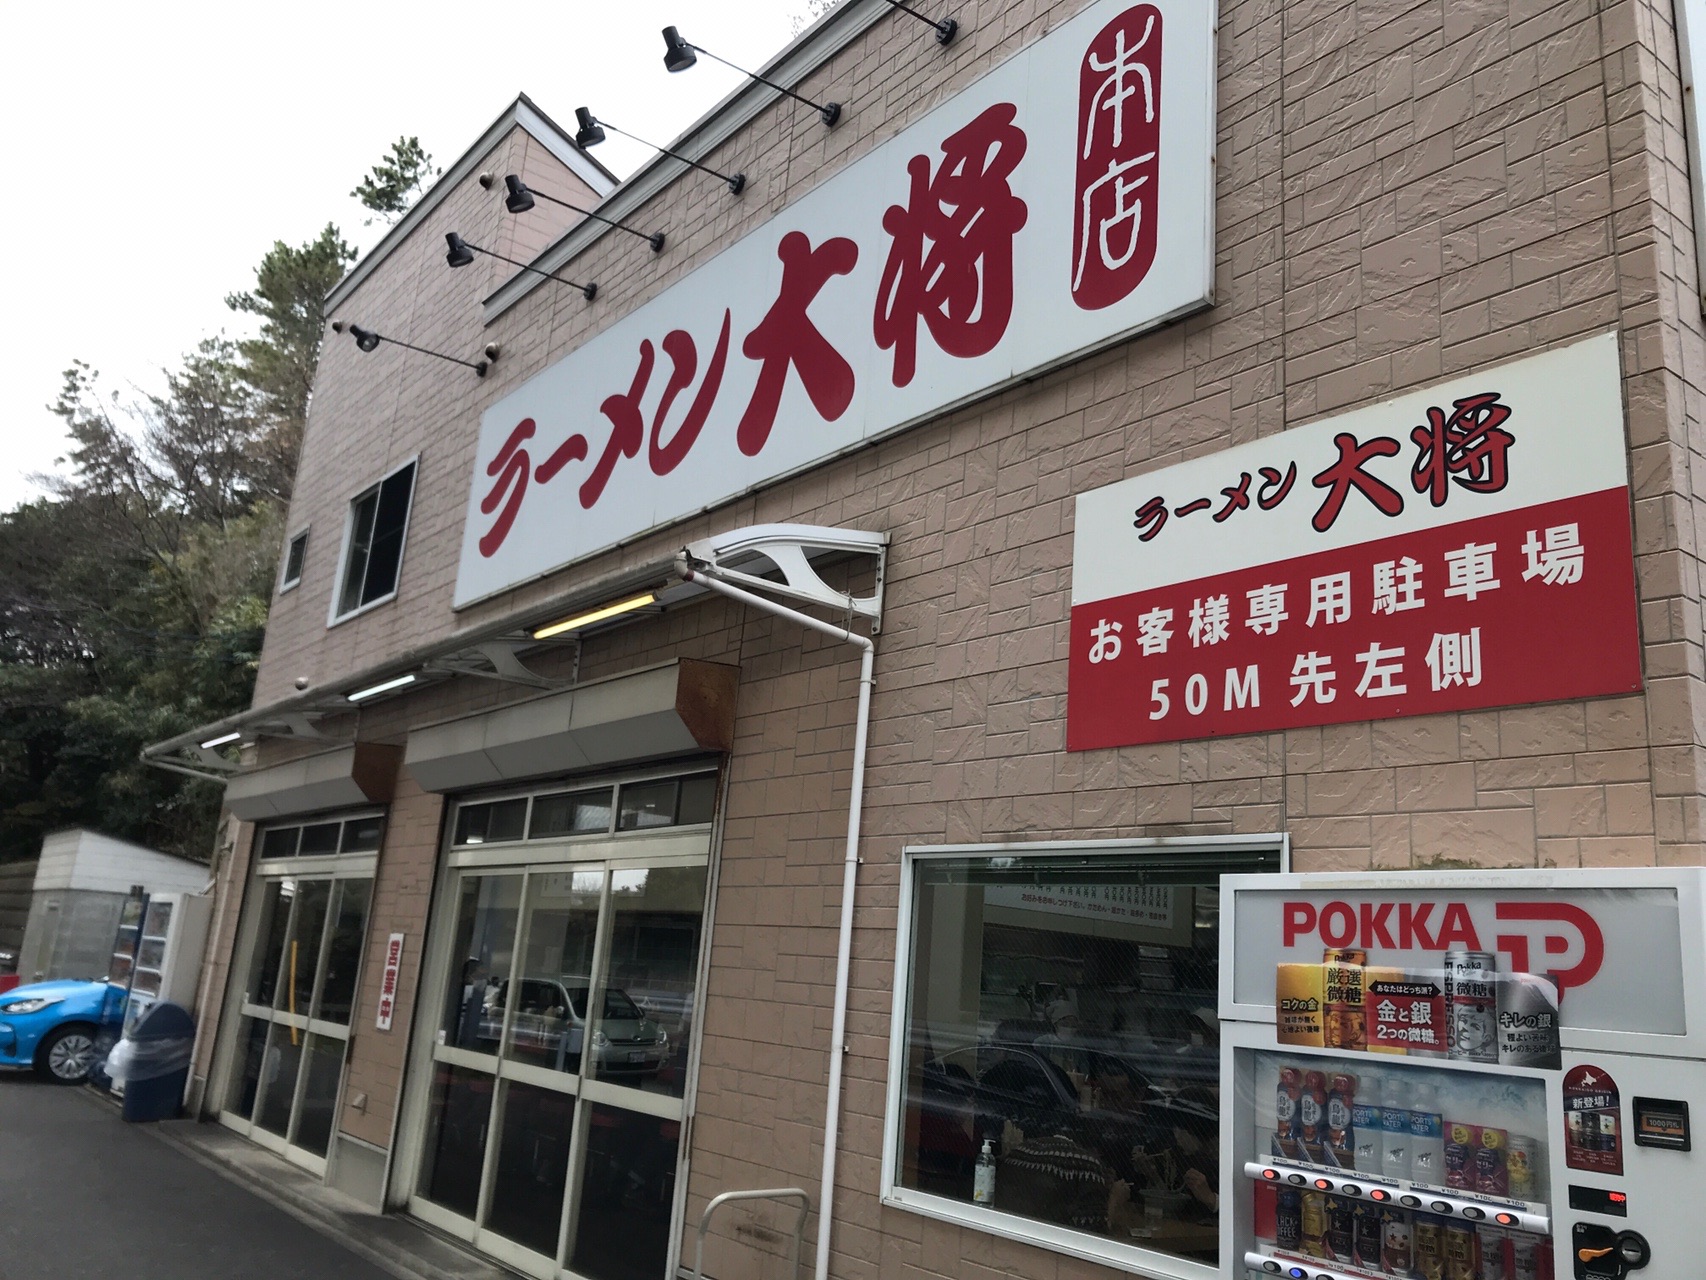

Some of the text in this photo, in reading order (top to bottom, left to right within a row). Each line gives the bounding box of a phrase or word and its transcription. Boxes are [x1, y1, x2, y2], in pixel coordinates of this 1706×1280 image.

[1073, 15, 1156, 293] 本店
[1088, 522, 1585, 664] お客様専用駐車場
[1283, 901, 1483, 951] POKKA
[1281, 998, 1319, 1012] コクの金
[1376, 999, 1432, 1025] 金と銀
[1500, 1012, 1552, 1028] キレの銀
[1376, 1024, 1440, 1045] 2つの微糖。
